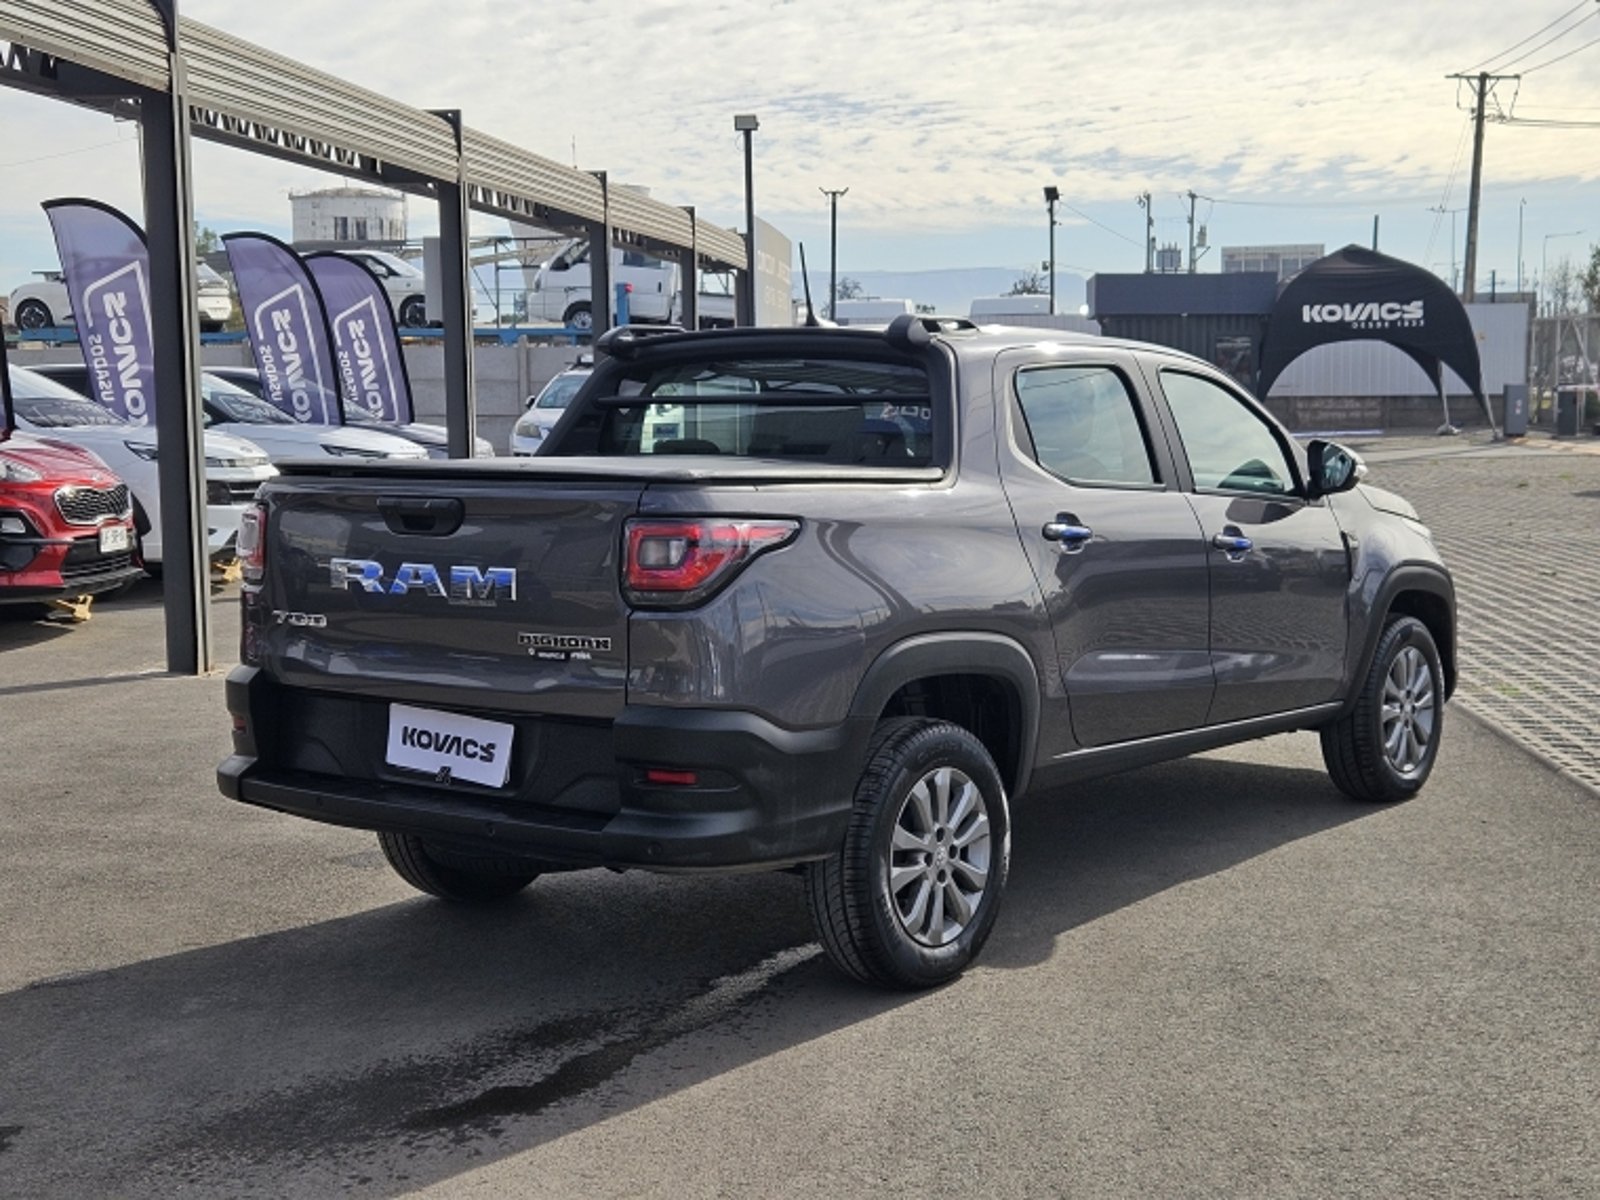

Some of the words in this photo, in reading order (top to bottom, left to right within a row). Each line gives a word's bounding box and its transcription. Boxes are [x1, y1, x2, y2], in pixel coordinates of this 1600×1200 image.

[1302, 300, 1424, 323] KOVACS
[329, 557, 517, 602] RAM
[402, 726, 496, 763] KOVACS
